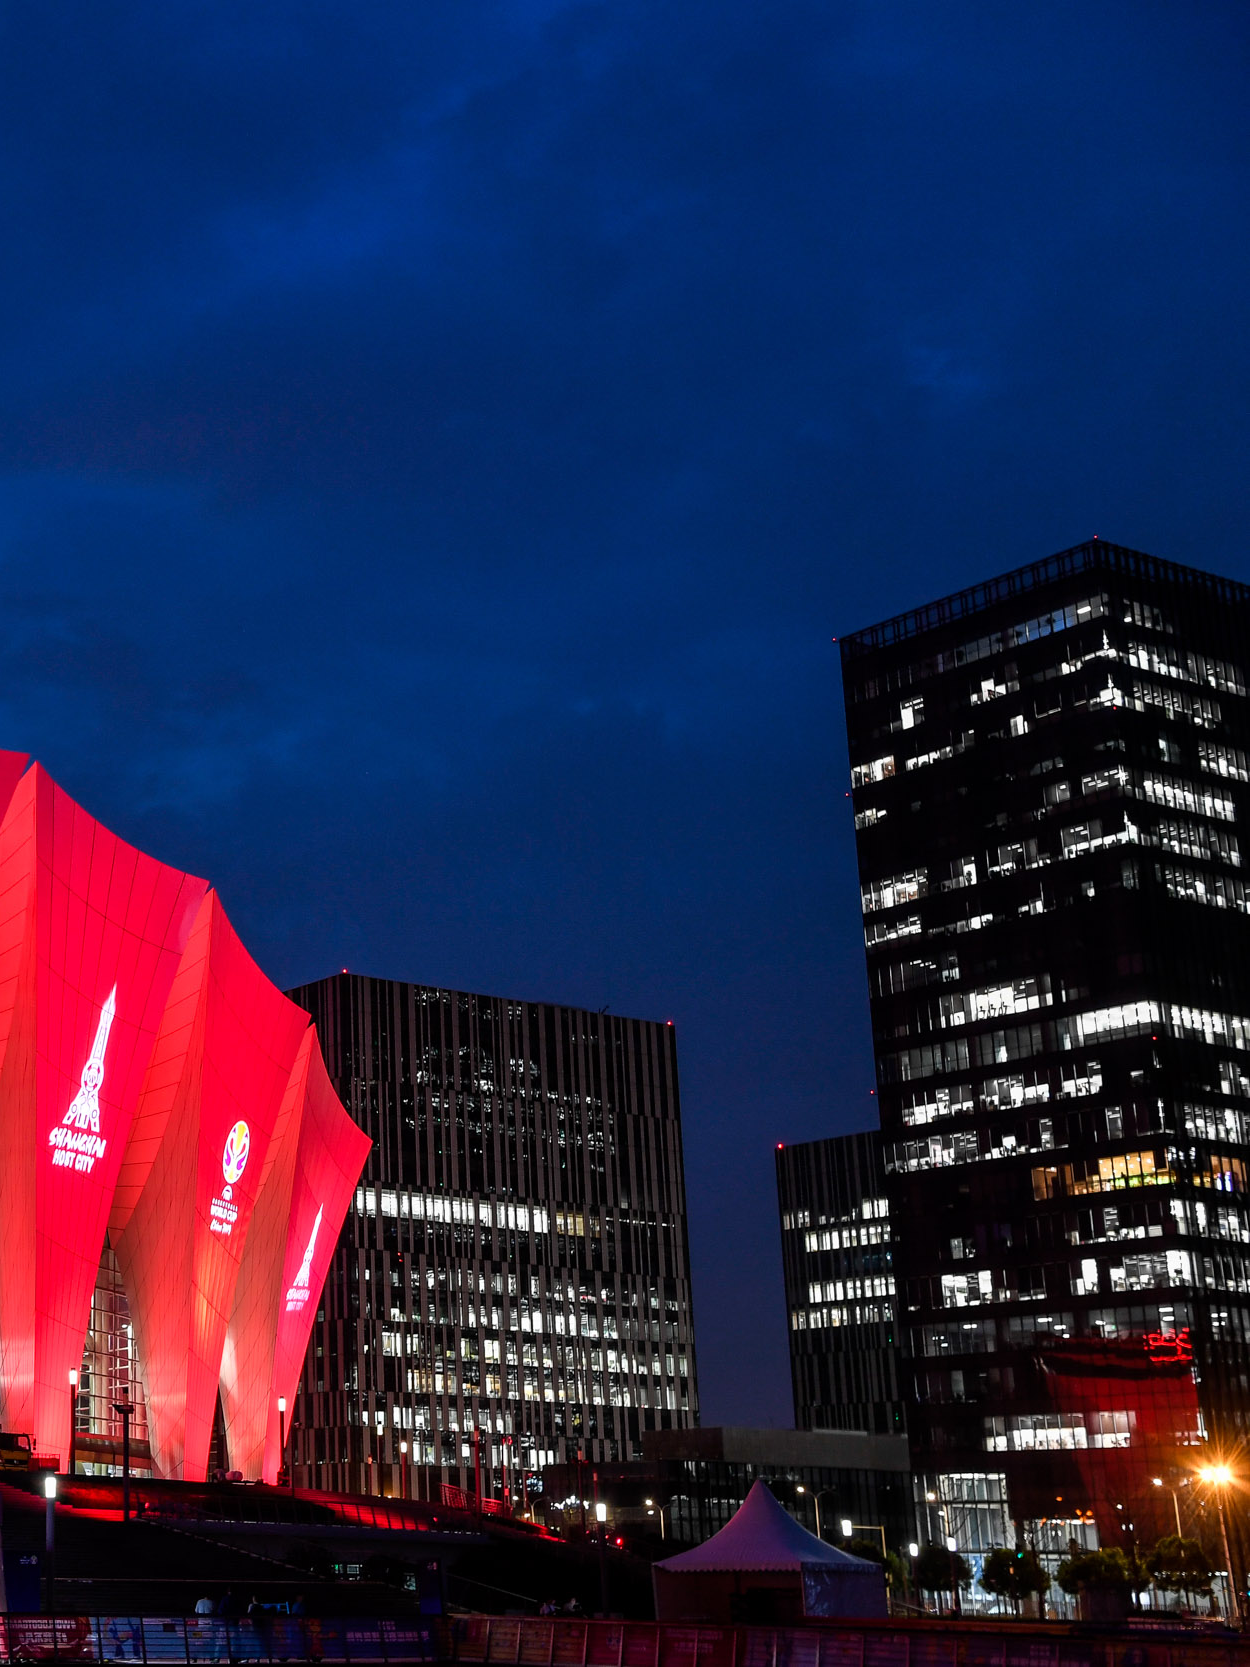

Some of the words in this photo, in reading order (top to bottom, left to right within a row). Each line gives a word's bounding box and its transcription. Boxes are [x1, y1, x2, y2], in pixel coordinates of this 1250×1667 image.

[48, 1126, 107, 1159] SHANGHAI
[52, 1148, 77, 1169] HOST
[74, 1153, 95, 1174] CITY
